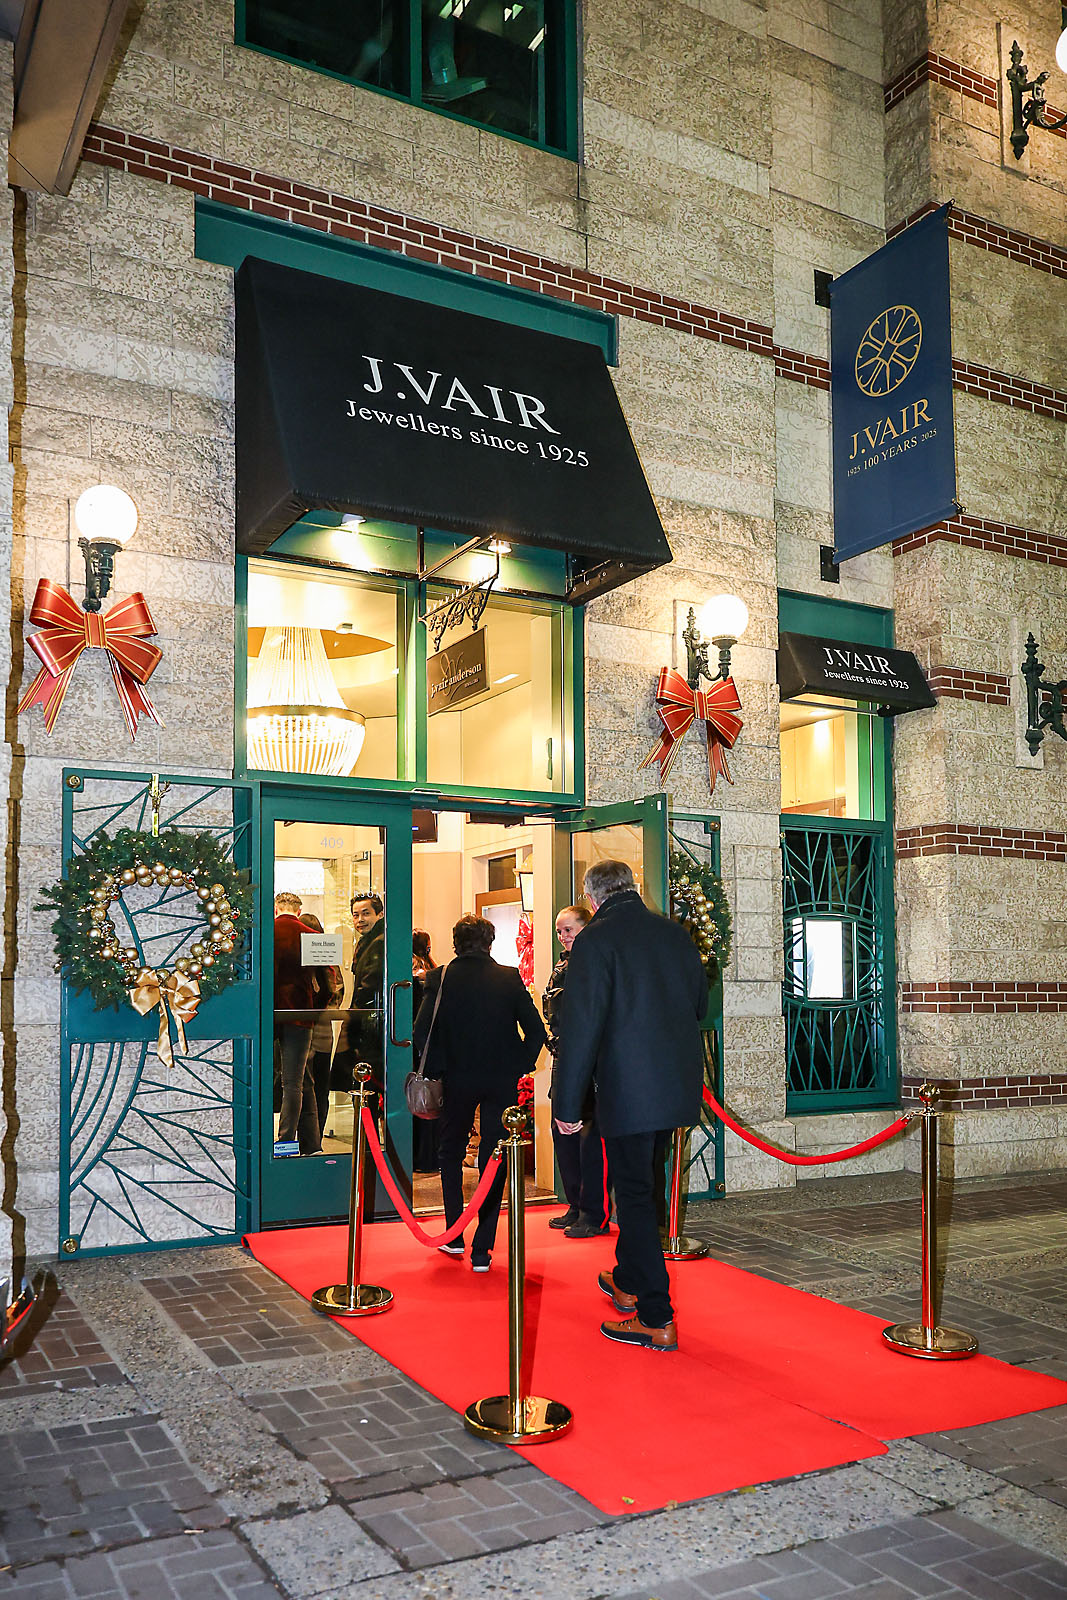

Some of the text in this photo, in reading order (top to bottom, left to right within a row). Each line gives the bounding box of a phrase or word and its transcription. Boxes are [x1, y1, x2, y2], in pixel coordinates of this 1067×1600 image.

[361, 354, 562, 435] J.VAIR
[346, 399, 590, 468] Jewellers since 1925
[847, 428, 937, 477] 1925 100 YEARS 2025
[849, 398, 933, 459] J.VAIR
[823, 647, 897, 676] J.VAIR
[824, 668, 910, 690] Jewellers since 1925
[320, 836, 344, 849] 409
